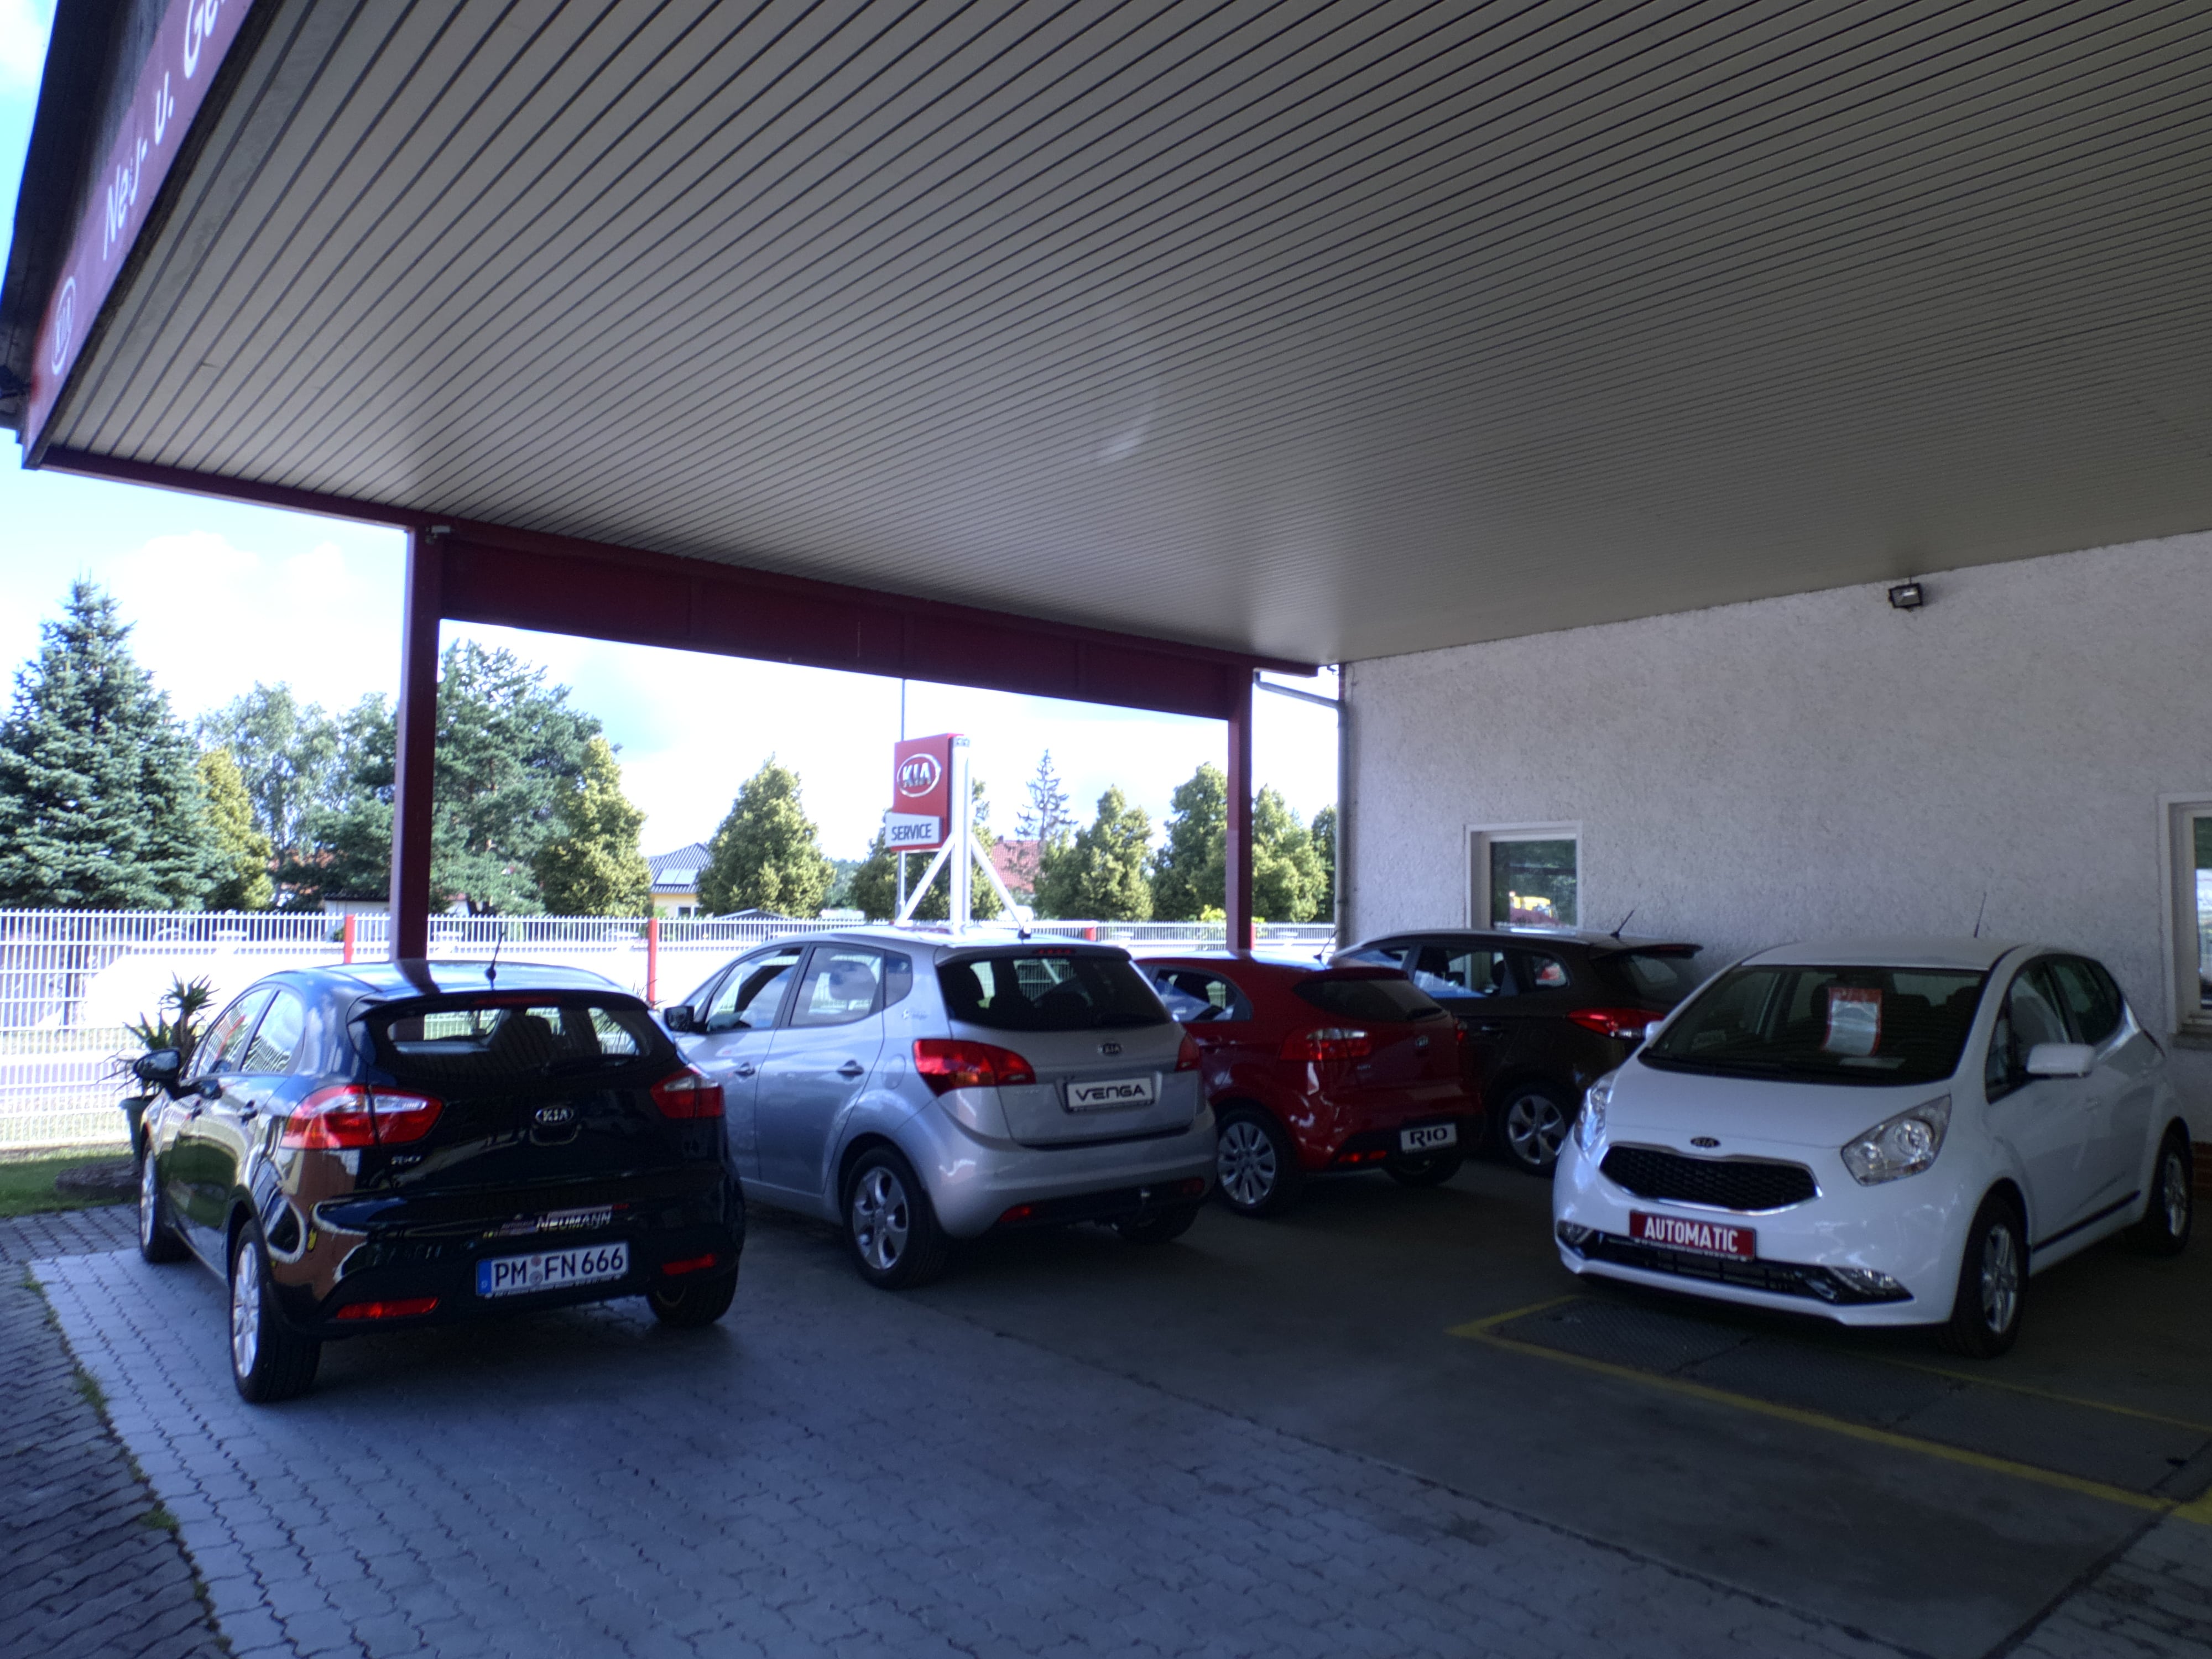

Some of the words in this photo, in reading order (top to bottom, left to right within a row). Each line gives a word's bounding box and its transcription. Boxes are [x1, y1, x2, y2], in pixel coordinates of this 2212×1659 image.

[155, 71, 174, 146] u.
[184, 0, 221, 79] Ge
[902, 762, 932, 787] KIA
[891, 823, 932, 841] SERVICE
[1075, 1084, 1145, 1102] VENGA
[542, 1109, 568, 1123] KIA
[1410, 1127, 1448, 1146] RIO
[1644, 1216, 1739, 1253] AUTOMATIC
[494, 1260, 526, 1287] PM
[544, 1253, 576, 1281] FN
[581, 1247, 624, 1275] 666
